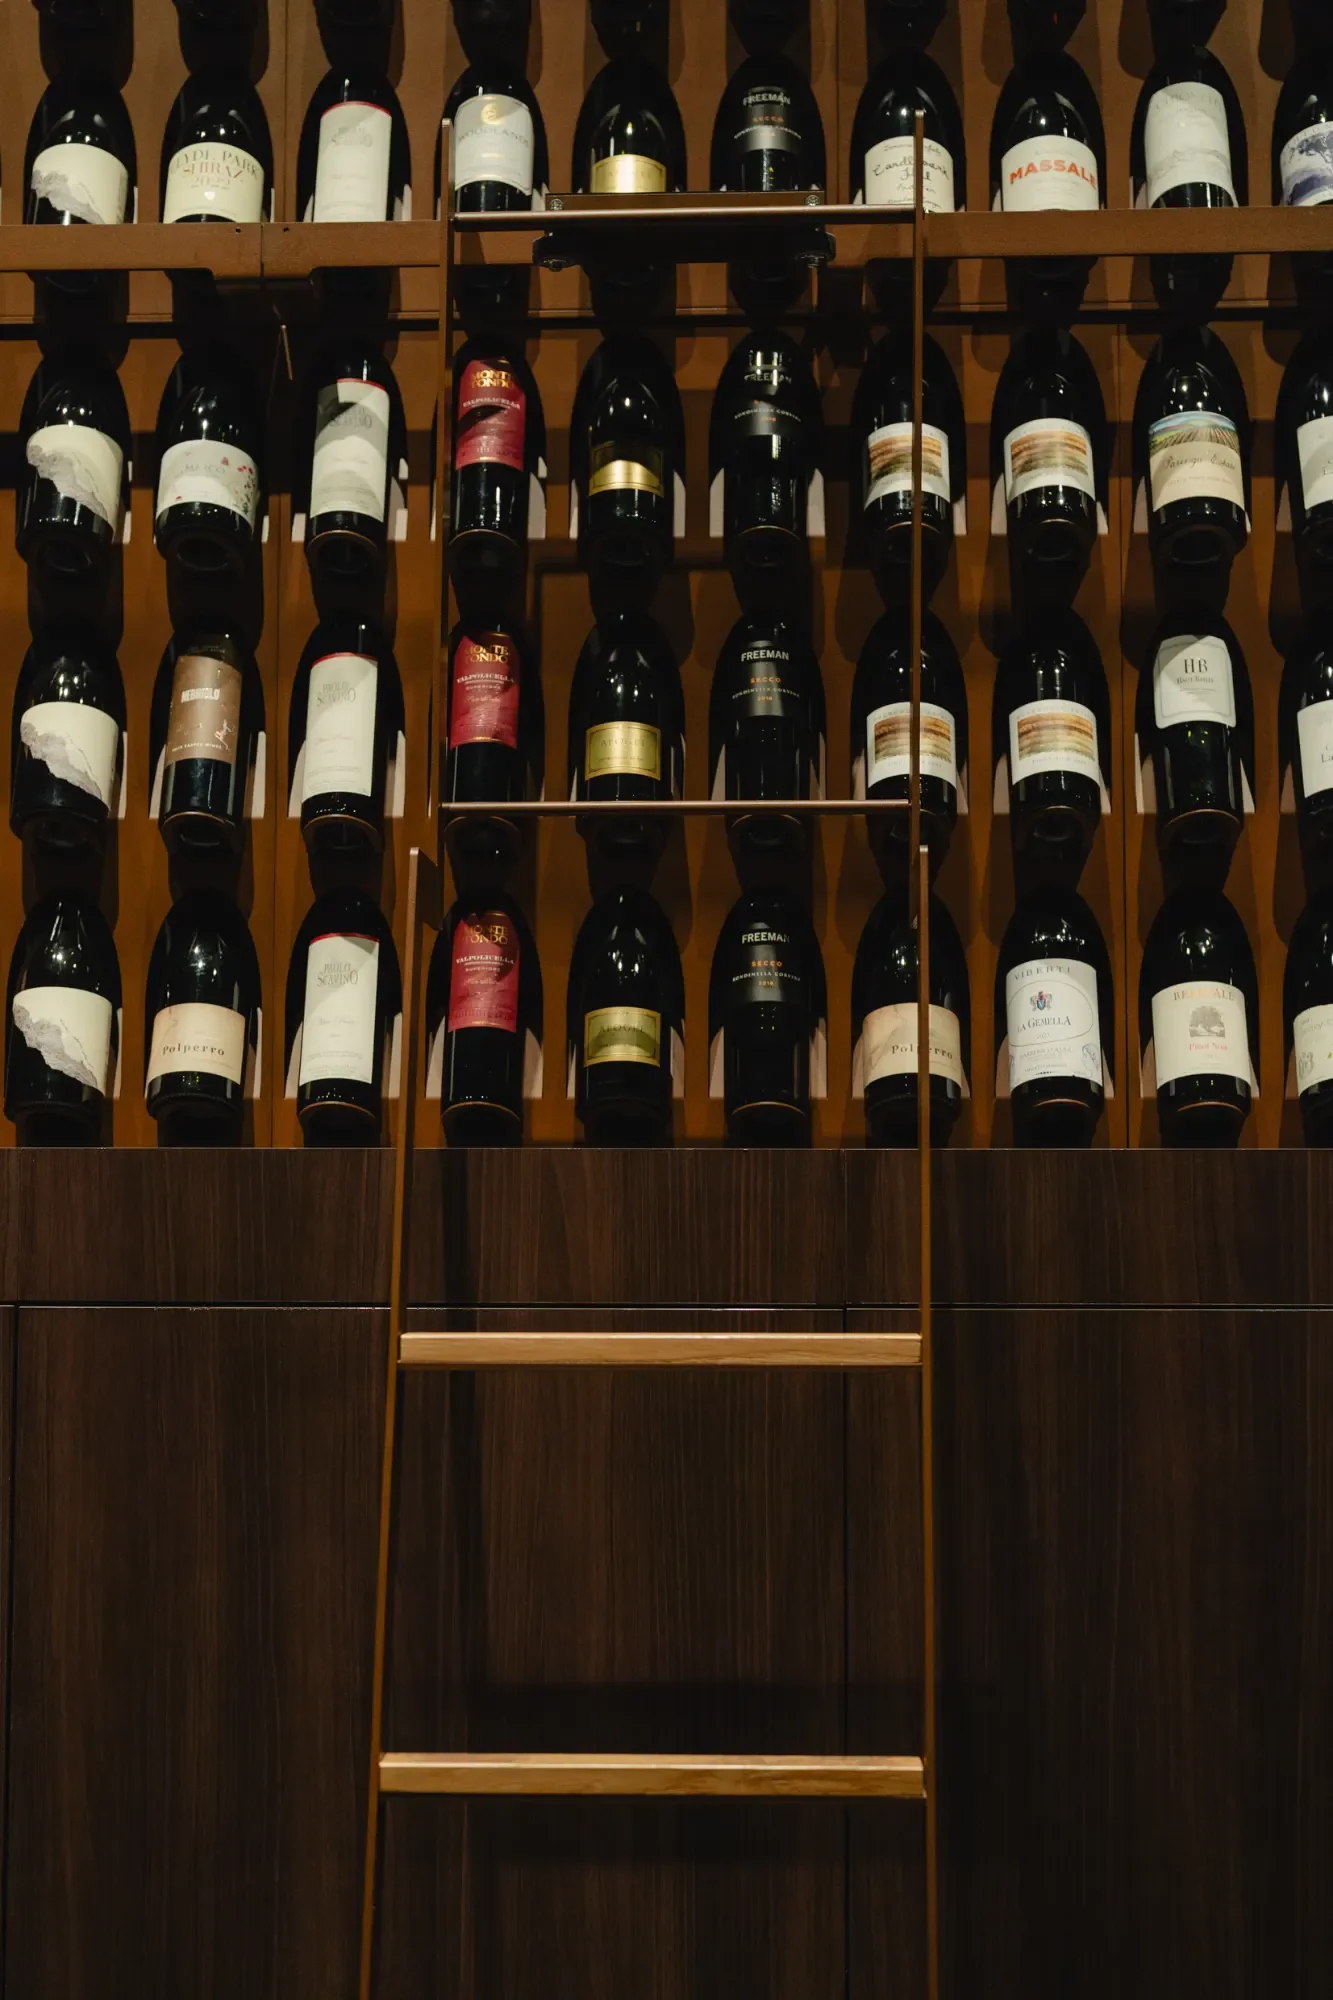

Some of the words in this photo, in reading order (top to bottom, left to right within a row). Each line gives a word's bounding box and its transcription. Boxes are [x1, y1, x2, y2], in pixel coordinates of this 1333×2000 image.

[742, 93, 791, 106] FREEMAN
[1009, 159, 1098, 191] MASSALE
[743, 371, 793, 385] FREEAN
[740, 649, 790, 663] FREEMAN
[750, 676, 782, 684] SECCO
[741, 931, 790, 944] FREEMAN
[323, 963, 351, 974] PAOLO
[751, 959, 783, 968] SECCO
[316, 968, 359, 988] SCAVINO
[1013, 964, 1072, 981] VIBERTI
[1173, 986, 1234, 1001] BELLALE
[1027, 1015, 1072, 1030] GEMELLA
[162, 1042, 225, 1057] Polperro
[891, 1043, 954, 1061] Polrro
